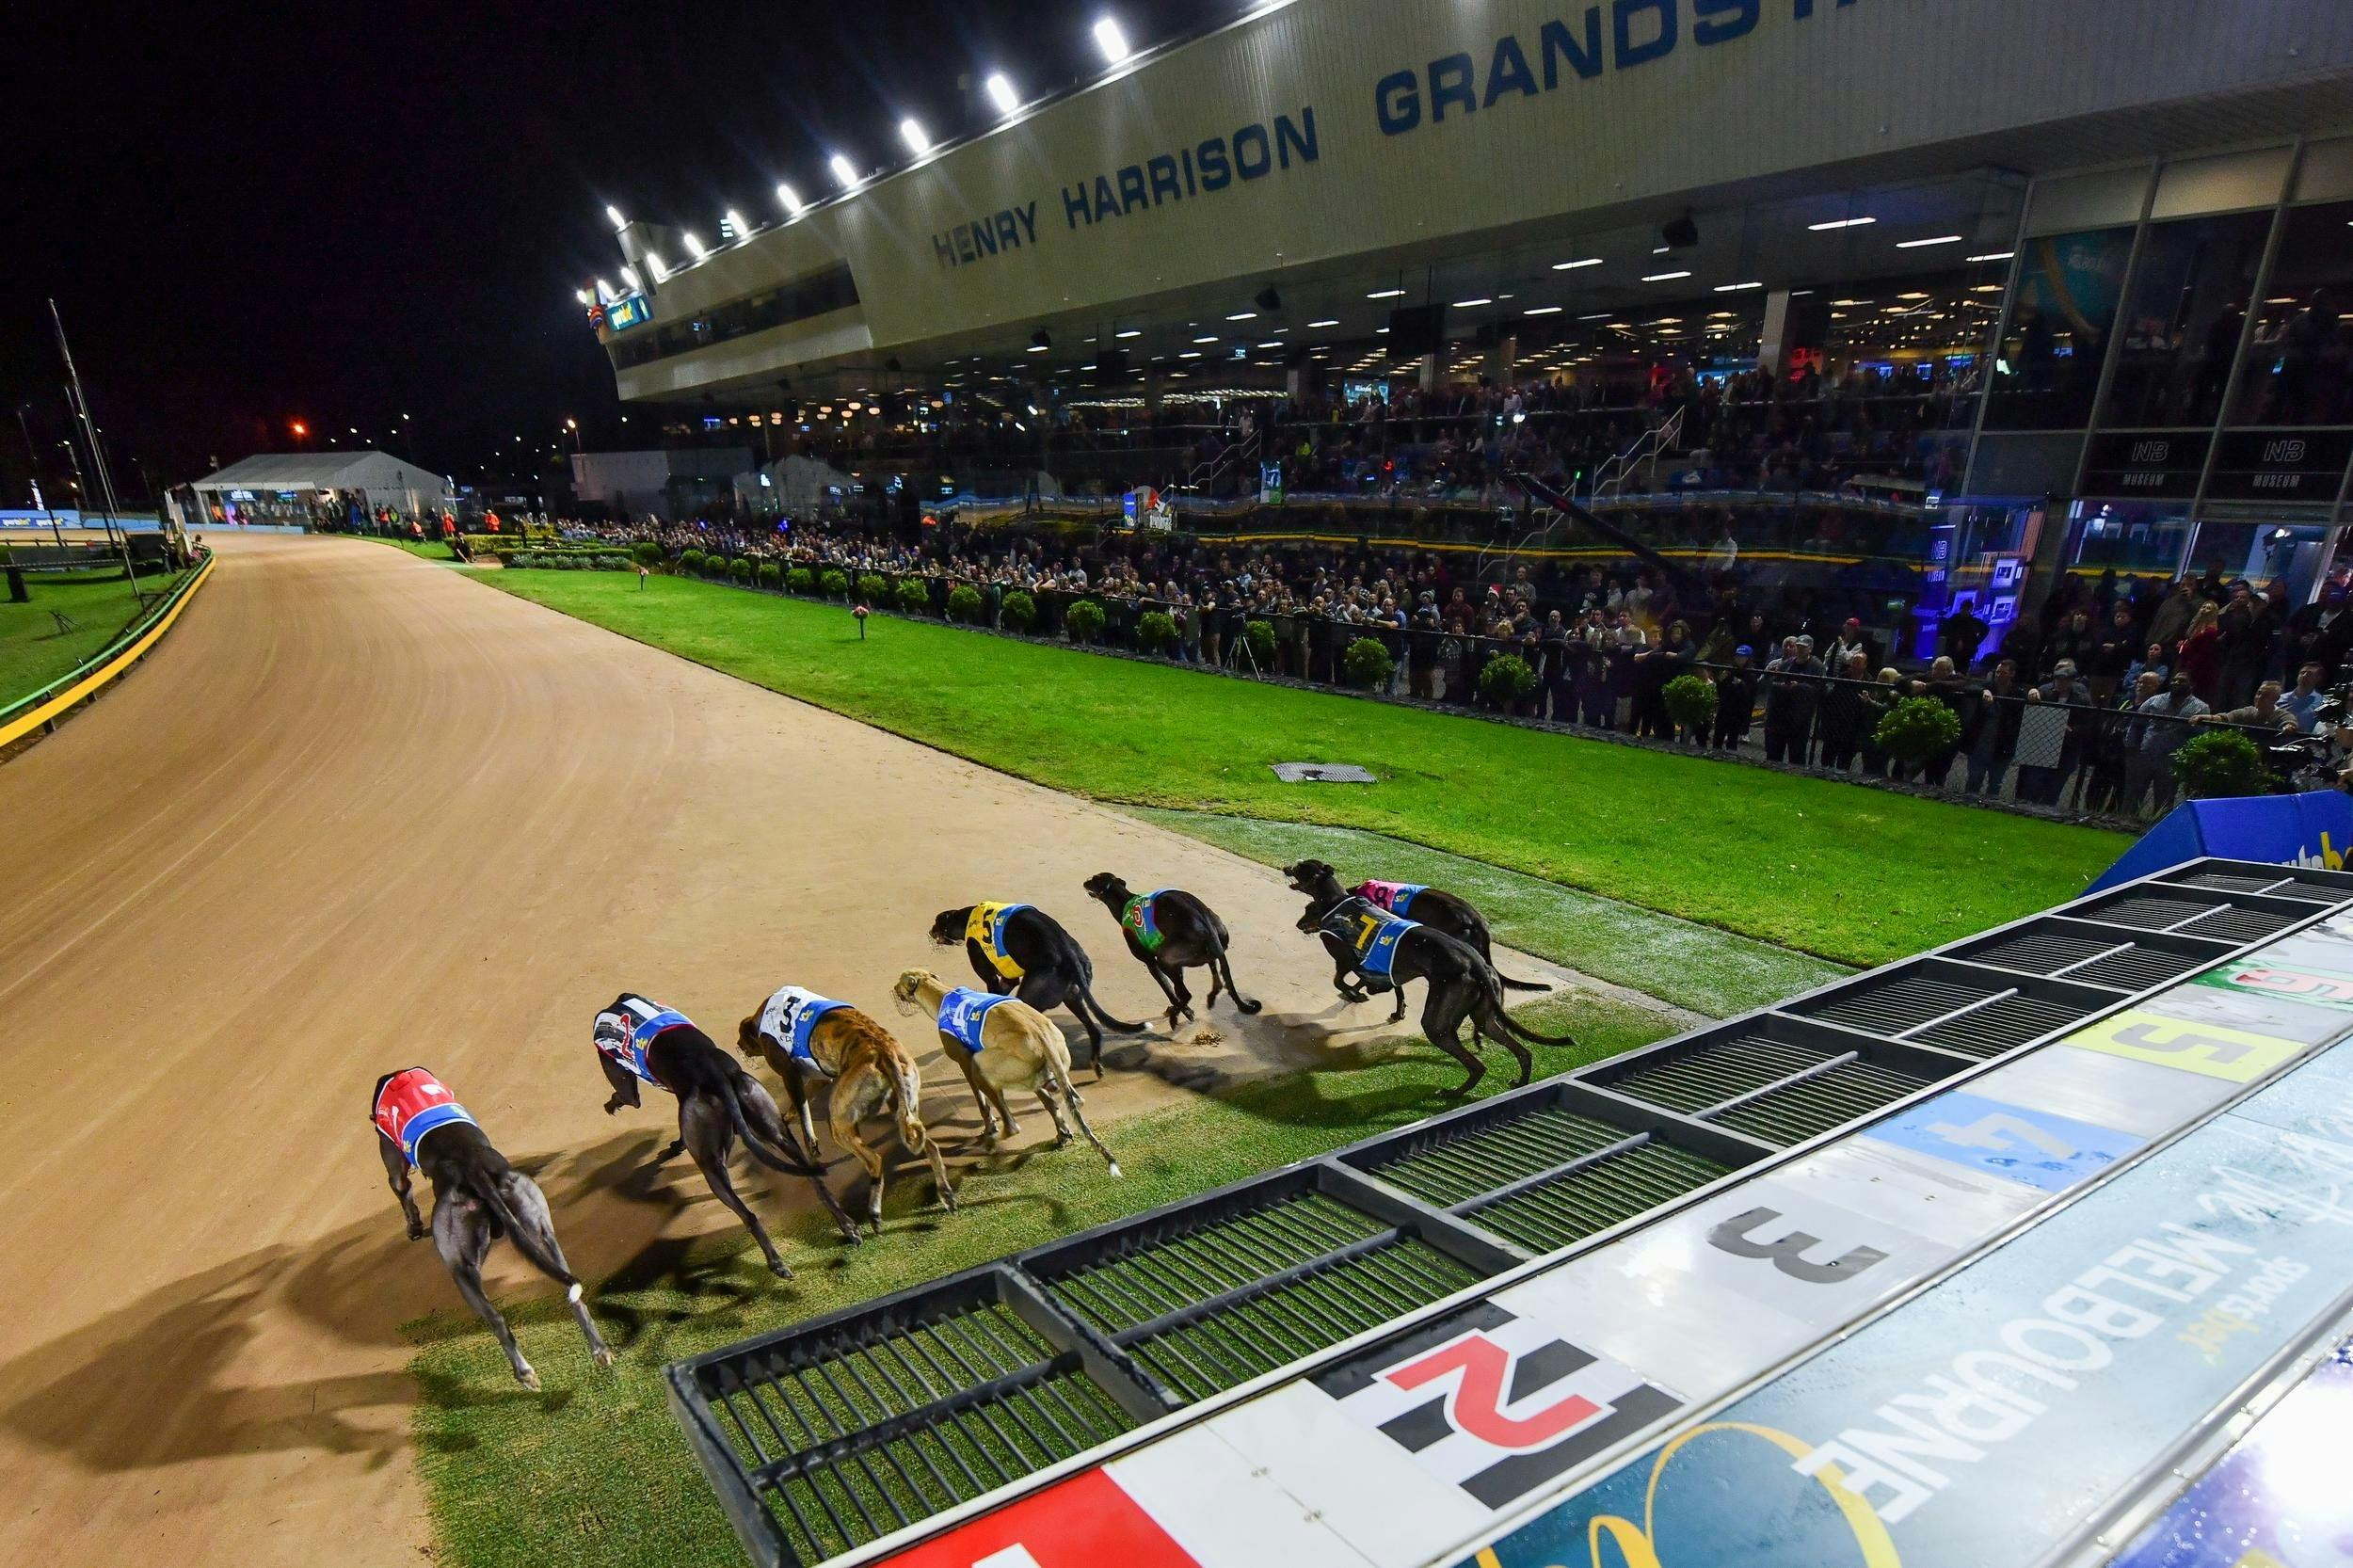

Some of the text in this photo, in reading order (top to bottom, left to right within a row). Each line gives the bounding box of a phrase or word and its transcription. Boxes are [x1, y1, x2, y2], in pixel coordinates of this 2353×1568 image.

[932, 0, 1857, 269] HENRY HARRISON GRANDS
[2122, 473, 2165, 487] MUSEUM
[2251, 473, 2300, 488] MUSEUM
[983, 908, 995, 944] 5
[1354, 912, 1379, 951] 7
[779, 995, 802, 1034] 3
[2111, 1023, 2255, 1064] 5
[1927, 1112, 2076, 1161] 4
[1705, 1206, 1890, 1284] 3
[2177, 1256, 2310, 1355] sportsbet
[1385, 1334, 1603, 1448] 2
[1791, 1223, 2256, 1525] MELBOURNE
